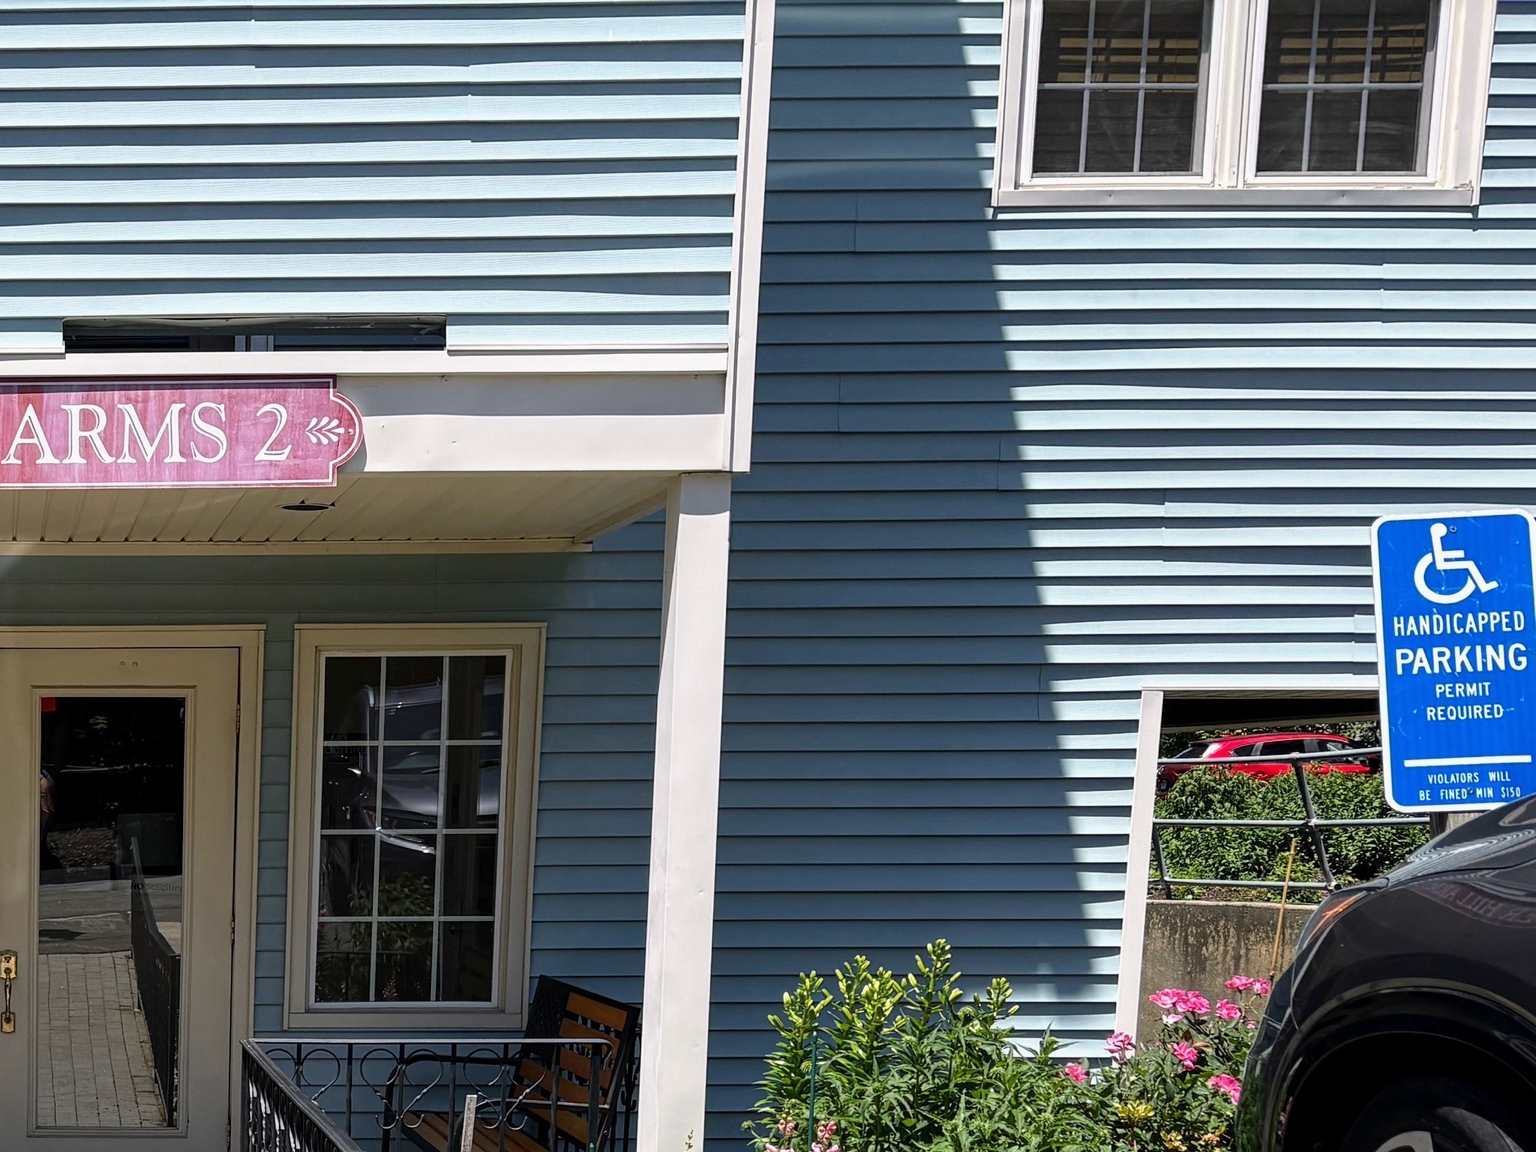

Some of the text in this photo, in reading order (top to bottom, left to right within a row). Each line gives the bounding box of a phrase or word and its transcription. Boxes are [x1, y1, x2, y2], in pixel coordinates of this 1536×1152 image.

[1, 401, 228, 466] ARMS
[253, 402, 295, 463] 2
[1393, 611, 1526, 636] HANDICAPPED
[1395, 643, 1528, 675] PARKING
[1435, 682, 1491, 698] PERMIT
[1427, 704, 1504, 721] REQUIRED
[1427, 771, 1511, 785] VIOLATORS WILL
[1419, 789, 1431, 801] BE
[1440, 787, 1468, 800] FINED
[1476, 786, 1494, 799] MIN
